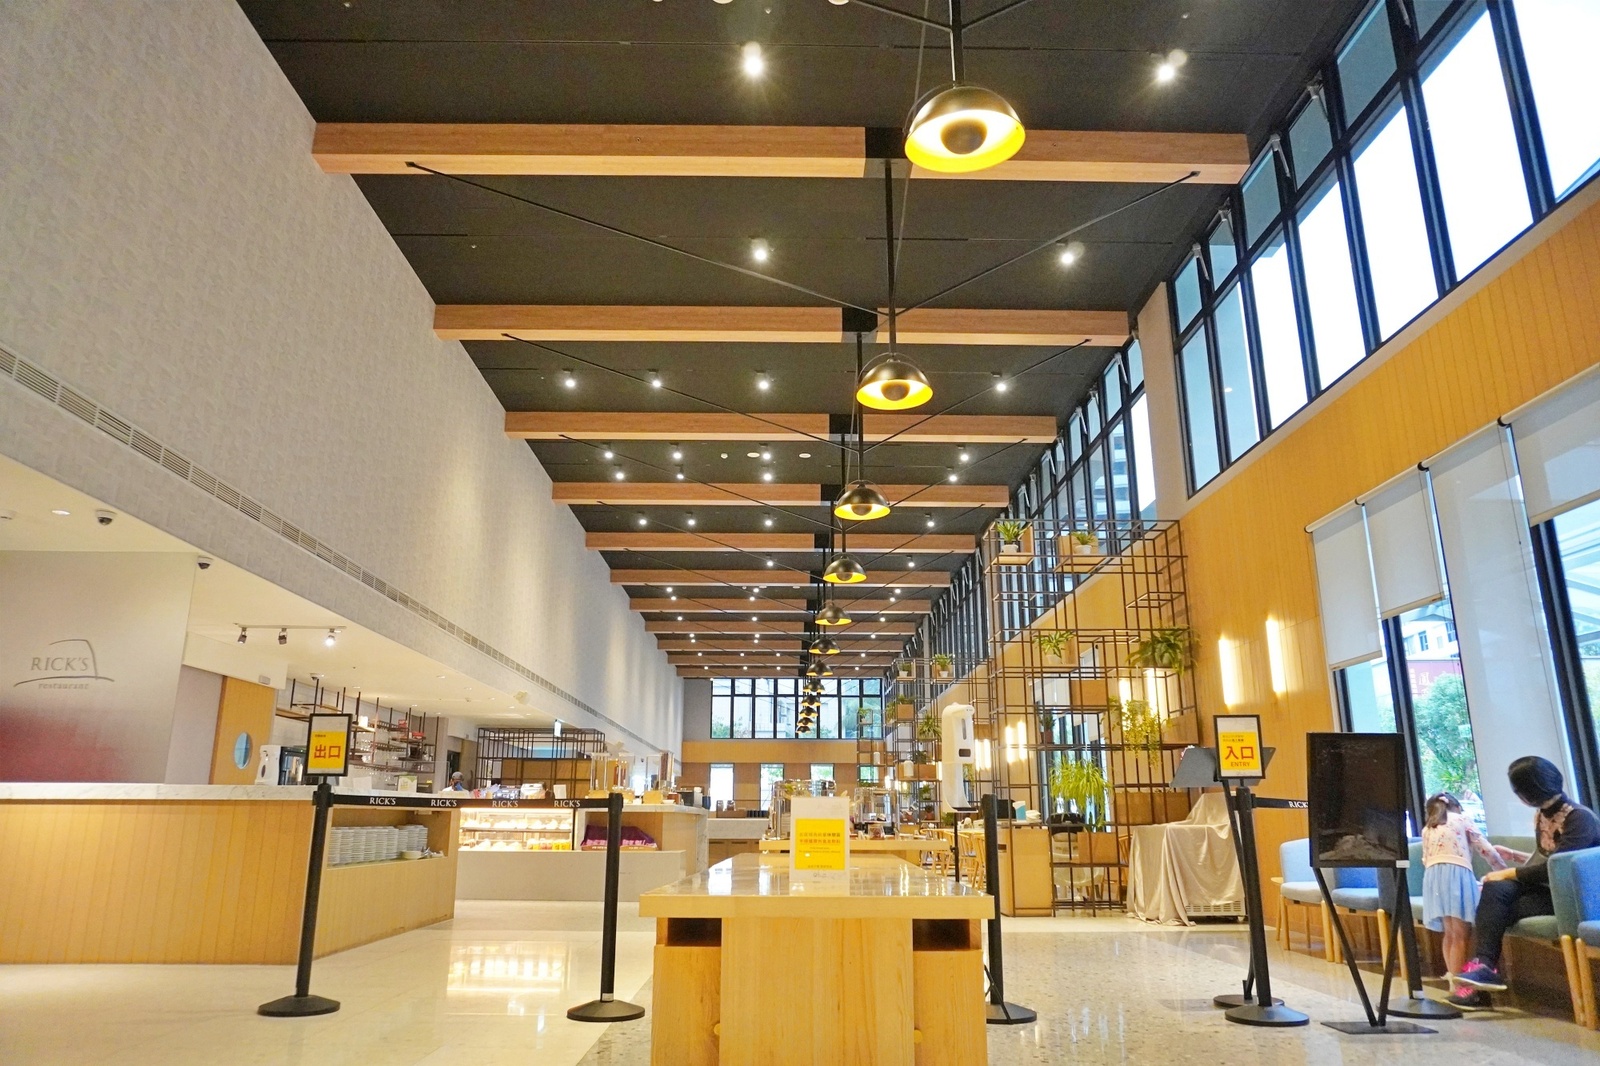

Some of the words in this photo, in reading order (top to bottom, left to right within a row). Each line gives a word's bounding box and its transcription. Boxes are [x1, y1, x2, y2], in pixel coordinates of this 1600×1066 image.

[31, 657, 89, 671] RICK'S
[314, 744, 341, 759] 出口
[1225, 746, 1254, 760] 入口
[369, 797, 396, 805] RICK'S
[431, 799, 457, 807] RICK'S
[492, 800, 519, 808] RICK'S
[554, 800, 580, 808] RICK'S
